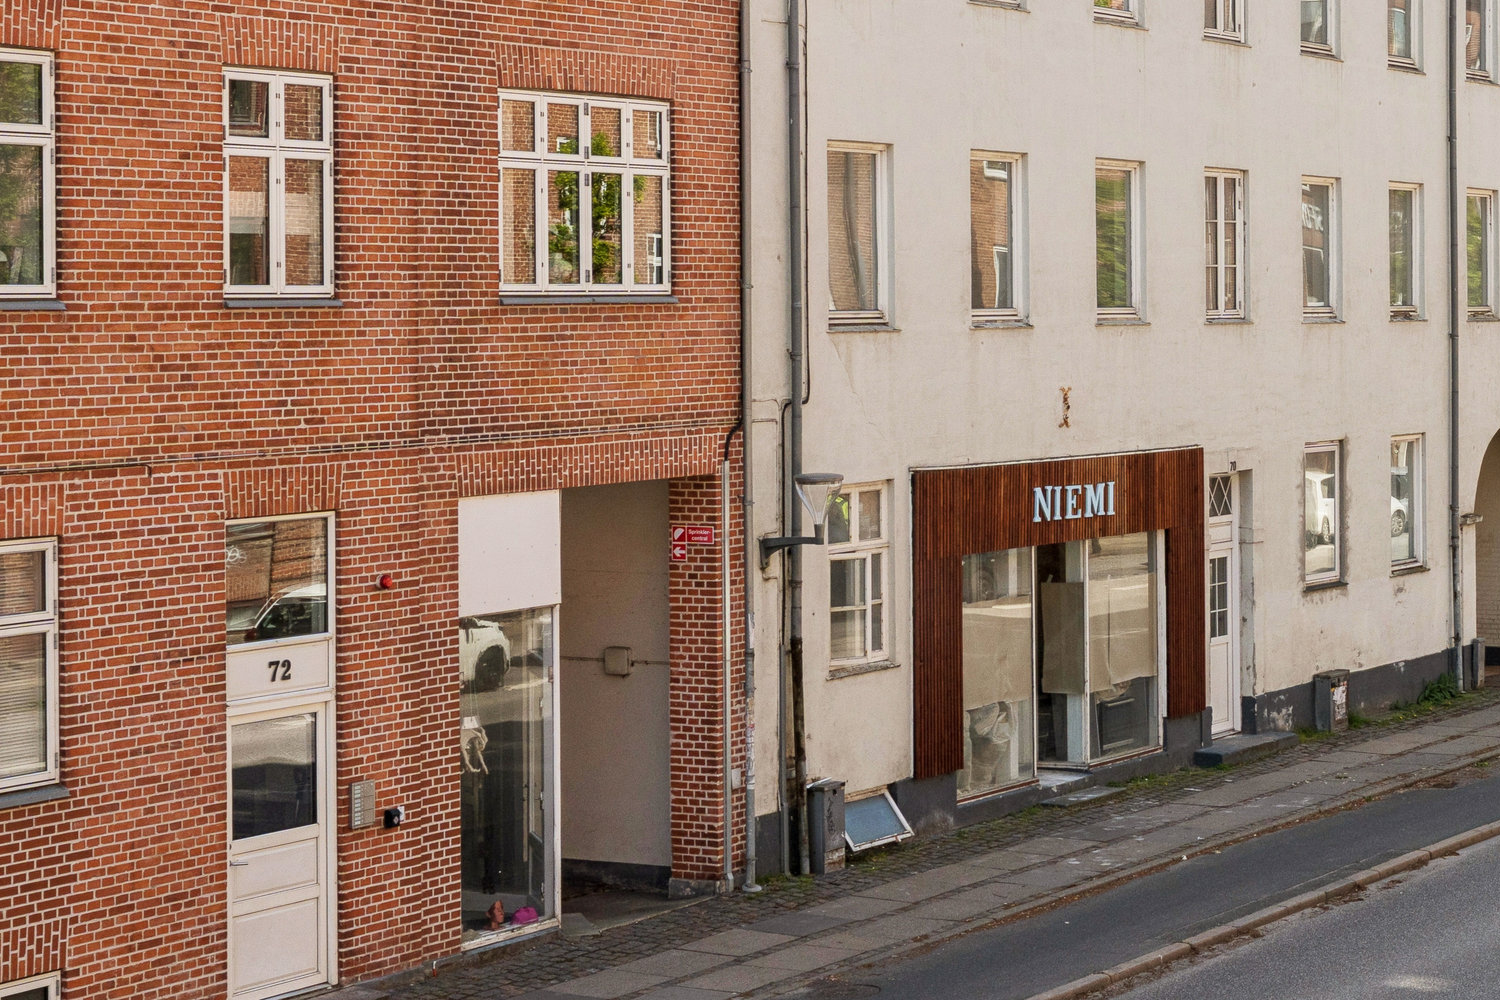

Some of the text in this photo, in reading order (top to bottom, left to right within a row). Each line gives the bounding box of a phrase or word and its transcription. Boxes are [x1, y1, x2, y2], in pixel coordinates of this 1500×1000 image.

[1230, 460, 1237, 471] 70
[1032, 481, 1115, 523] NIEMI
[268, 659, 292, 683] 72
